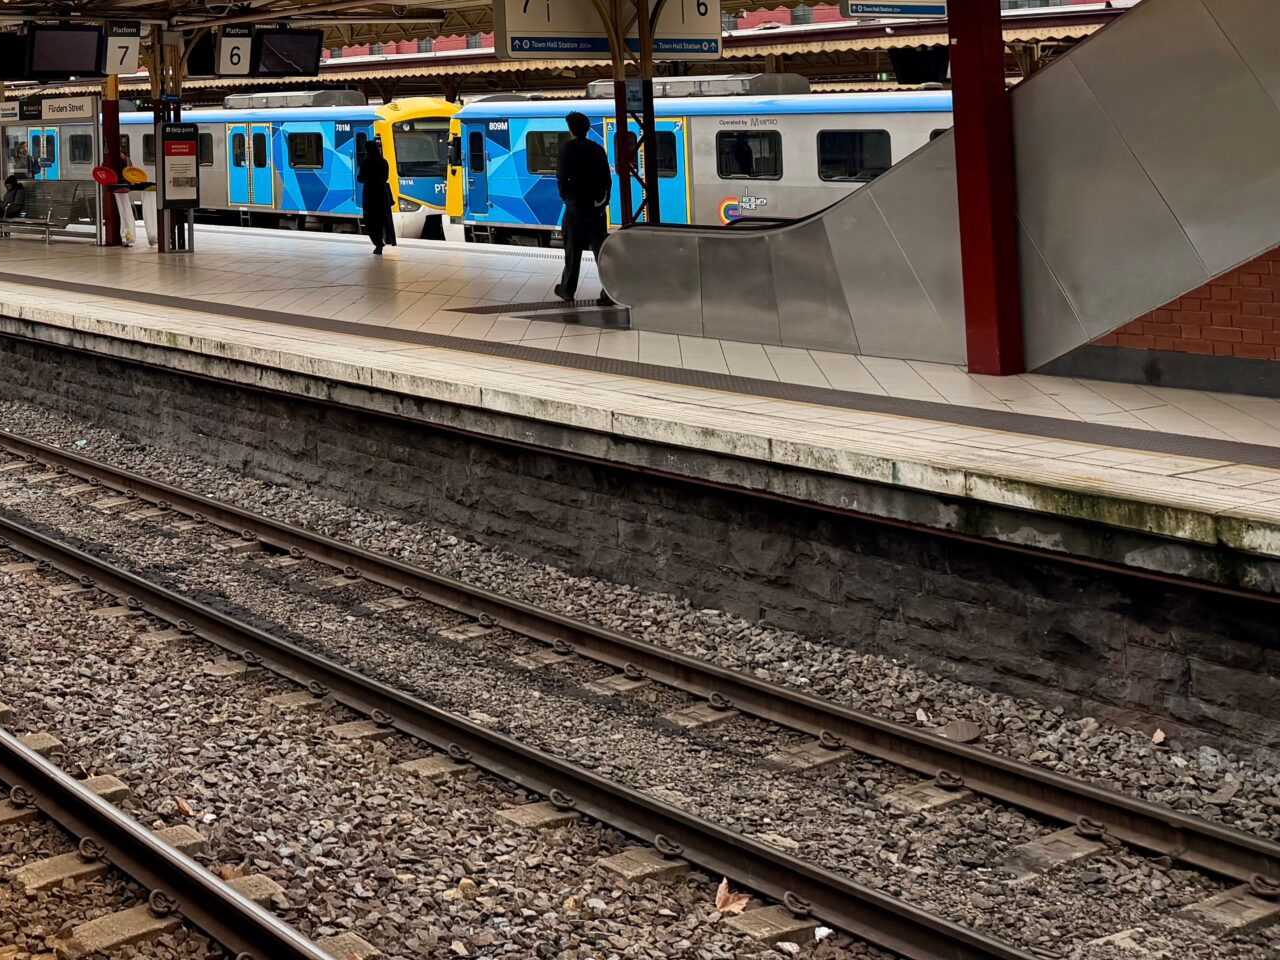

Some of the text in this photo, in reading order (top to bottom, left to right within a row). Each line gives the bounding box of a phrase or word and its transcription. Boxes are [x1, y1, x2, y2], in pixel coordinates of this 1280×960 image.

[531, 41, 546, 49] Town
[547, 41, 558, 49] Hall
[559, 41, 578, 50] Station
[683, 42, 701, 50] Station
[117, 45, 130, 66] 7
[230, 46, 241, 66] 6
[48, 104, 67, 113] Flinders
[69, 103, 85, 112] Street
[335, 123, 351, 132] 781M
[489, 122, 508, 131] 809M
[434, 183, 448, 194] PT
